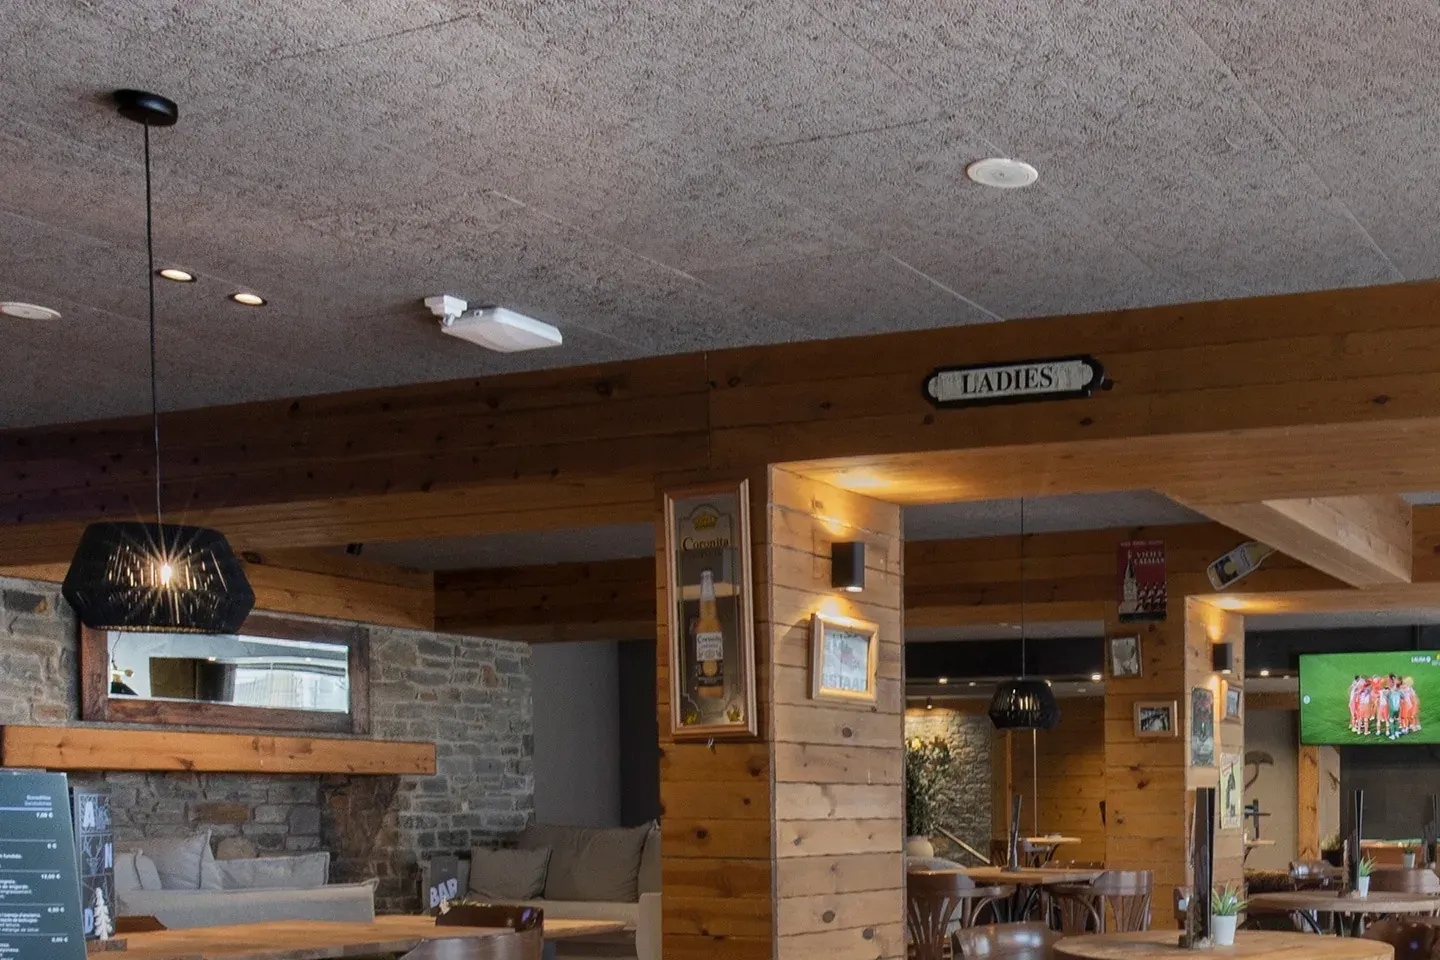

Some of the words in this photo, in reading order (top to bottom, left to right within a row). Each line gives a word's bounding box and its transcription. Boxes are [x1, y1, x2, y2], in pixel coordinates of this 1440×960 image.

[961, 366, 1054, 395] LADIES
[682, 535, 730, 551] Coronita
[430, 878, 458, 908] BAR
